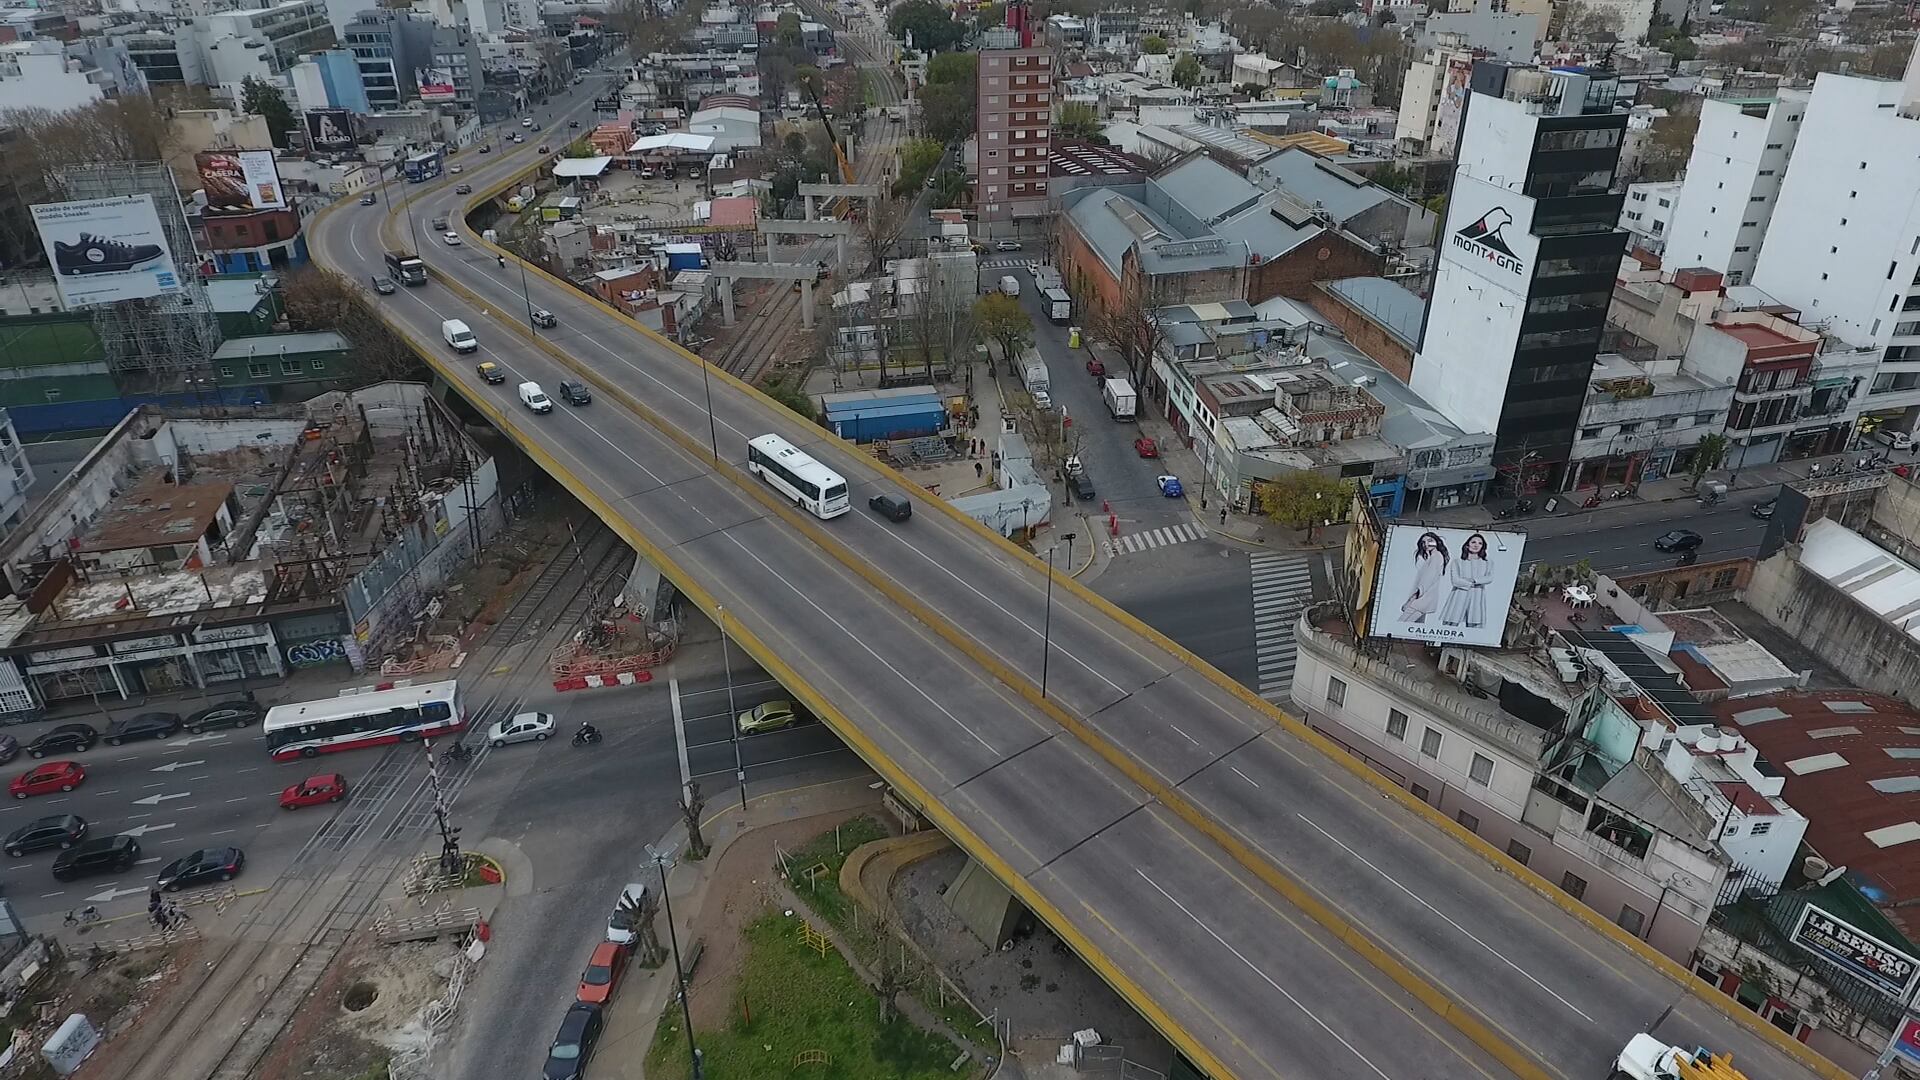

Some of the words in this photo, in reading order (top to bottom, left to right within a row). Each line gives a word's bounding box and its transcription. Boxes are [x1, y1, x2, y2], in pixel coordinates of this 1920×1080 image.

[313, 135, 351, 144] SOLEDAD
[204, 170, 241, 178] CASERA
[35, 206, 61, 214] Calzado
[72, 202, 105, 212] seguridad
[38, 212, 63, 220] modelo
[1453, 235, 1523, 275] MONTAGNE
[1407, 626, 1465, 638] CALANDRA
[1808, 914, 1835, 936] LA
[1836, 928, 1911, 974] BERISO
